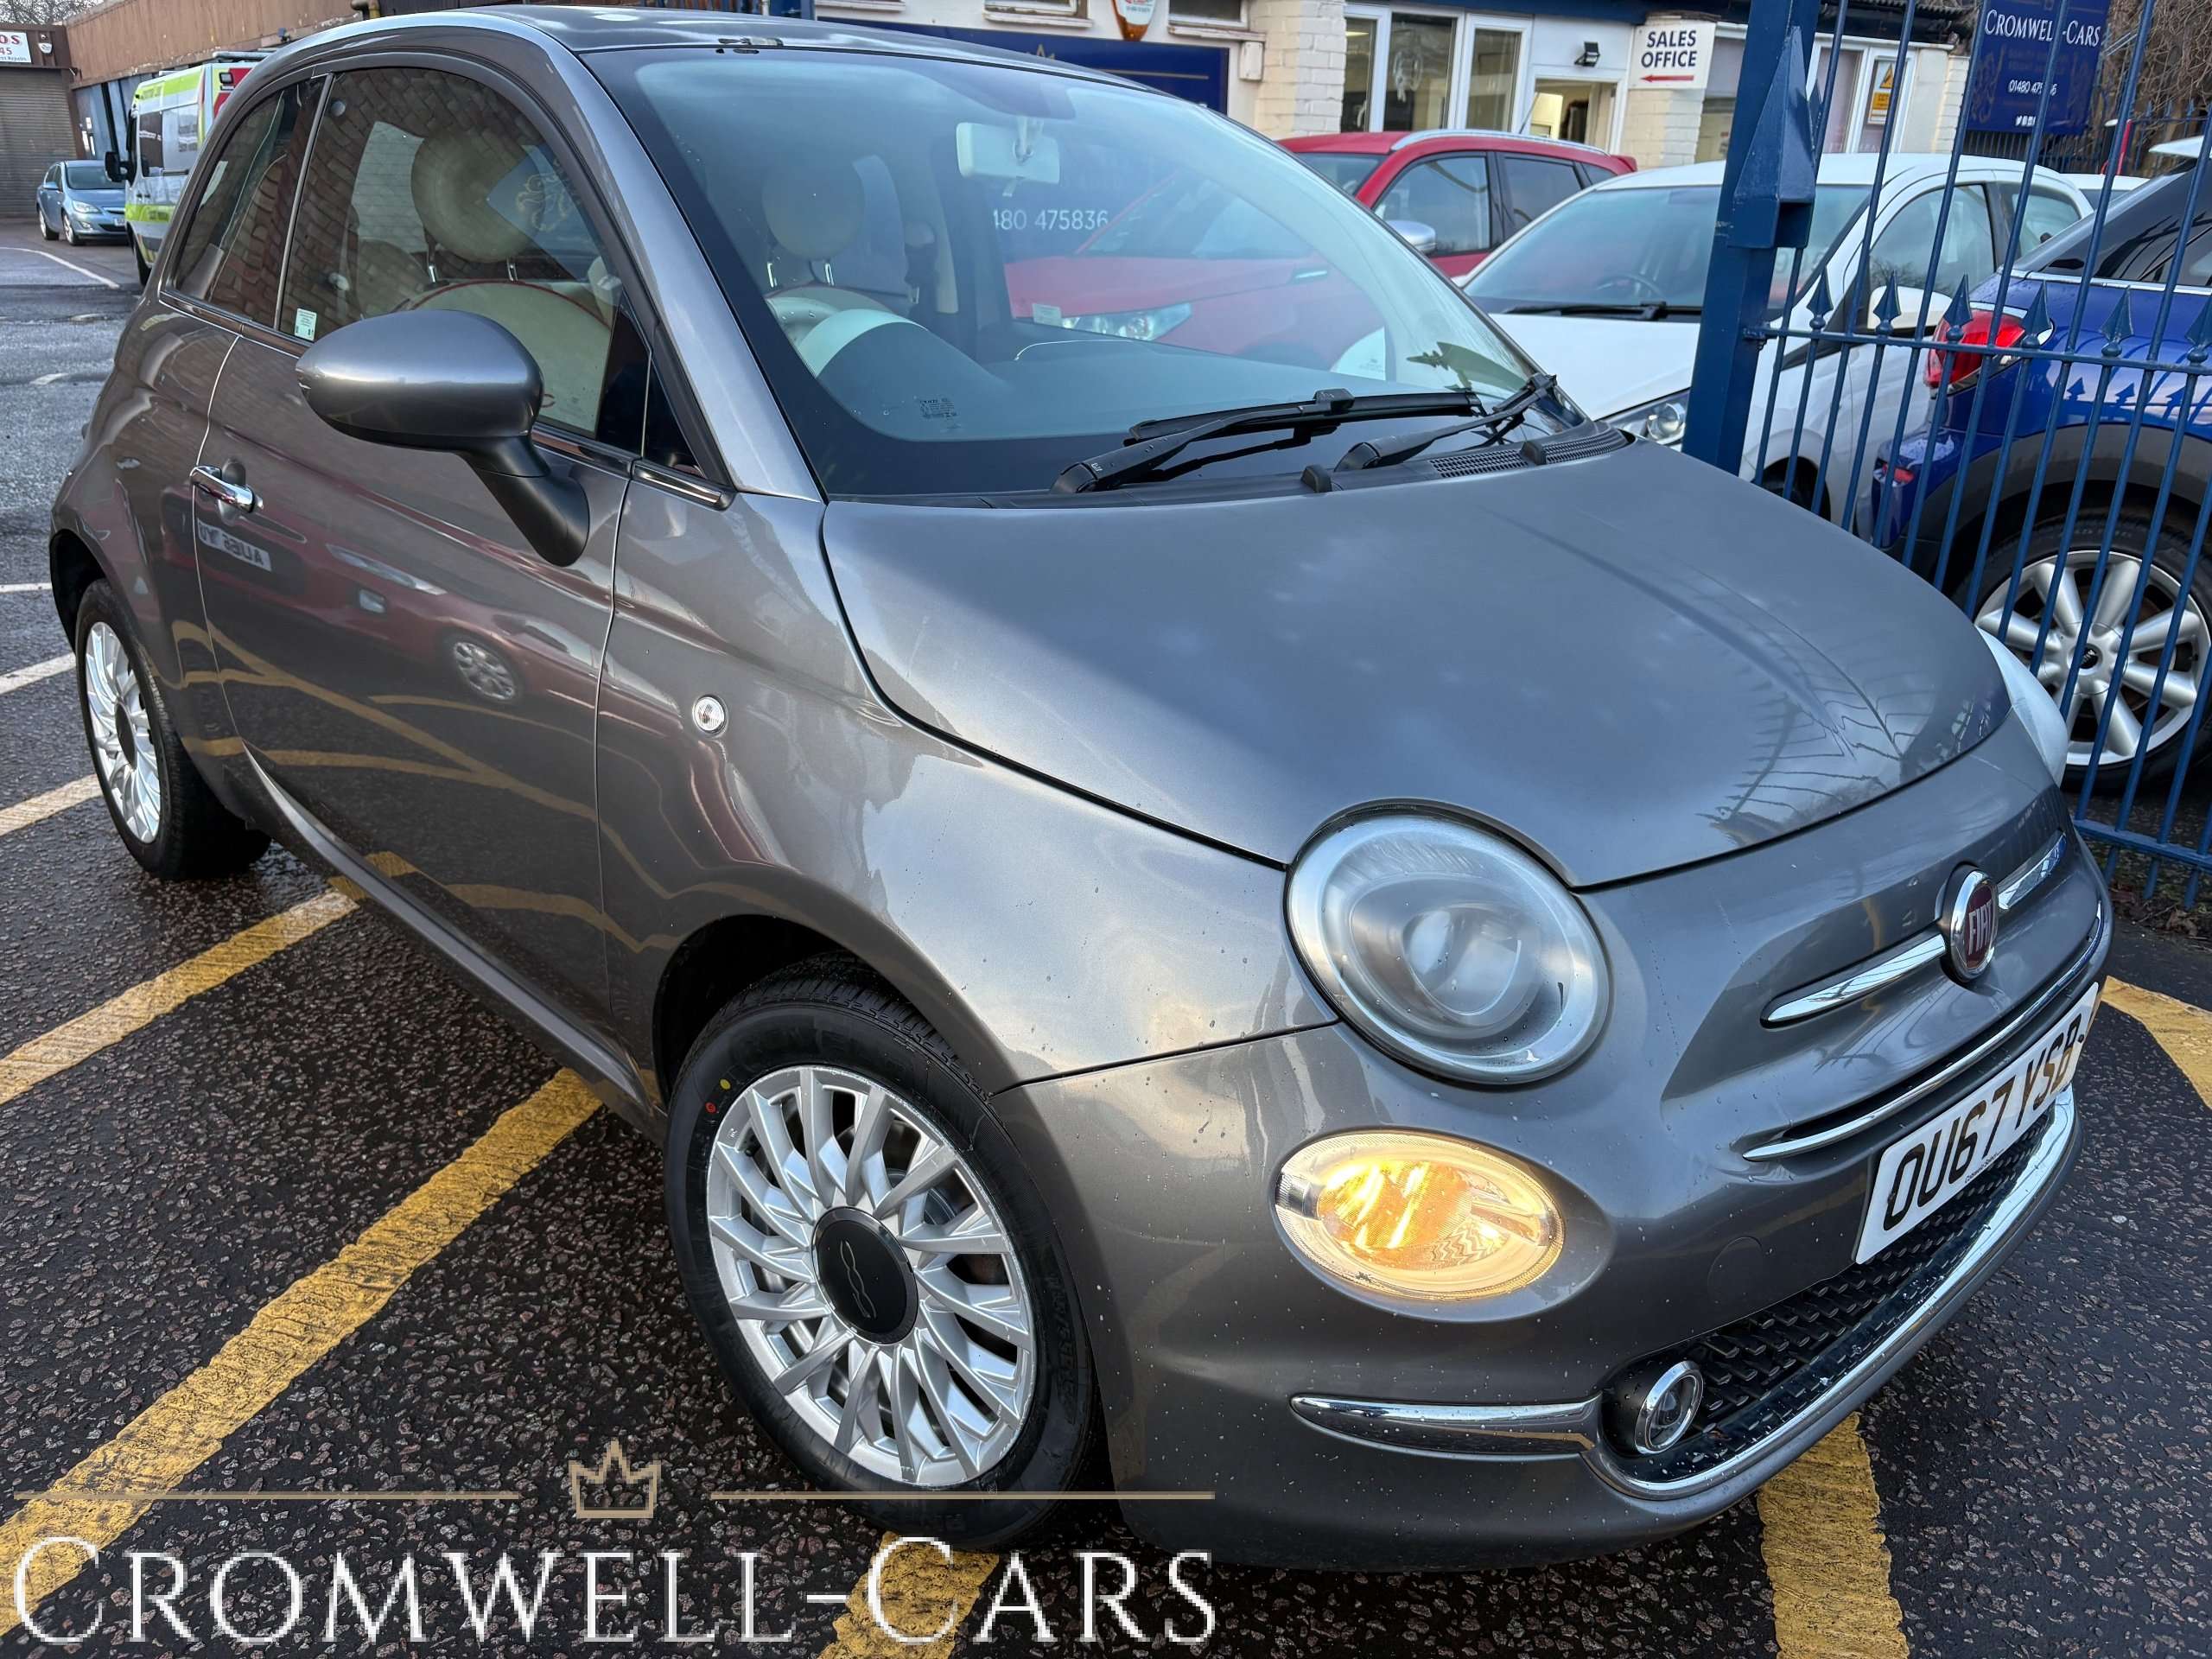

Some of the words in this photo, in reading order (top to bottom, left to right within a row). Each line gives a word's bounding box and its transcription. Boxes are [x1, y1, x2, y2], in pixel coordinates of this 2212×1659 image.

[1647, 30, 1696, 48] SALES
[1985, 10, 2101, 47] CROMWEL-CARS
[1641, 50, 1697, 67] OFFICE
[1035, 209, 1109, 230] 475836
[1968, 899, 1992, 956] FIAT
[1884, 1075, 2016, 1230] OU67
